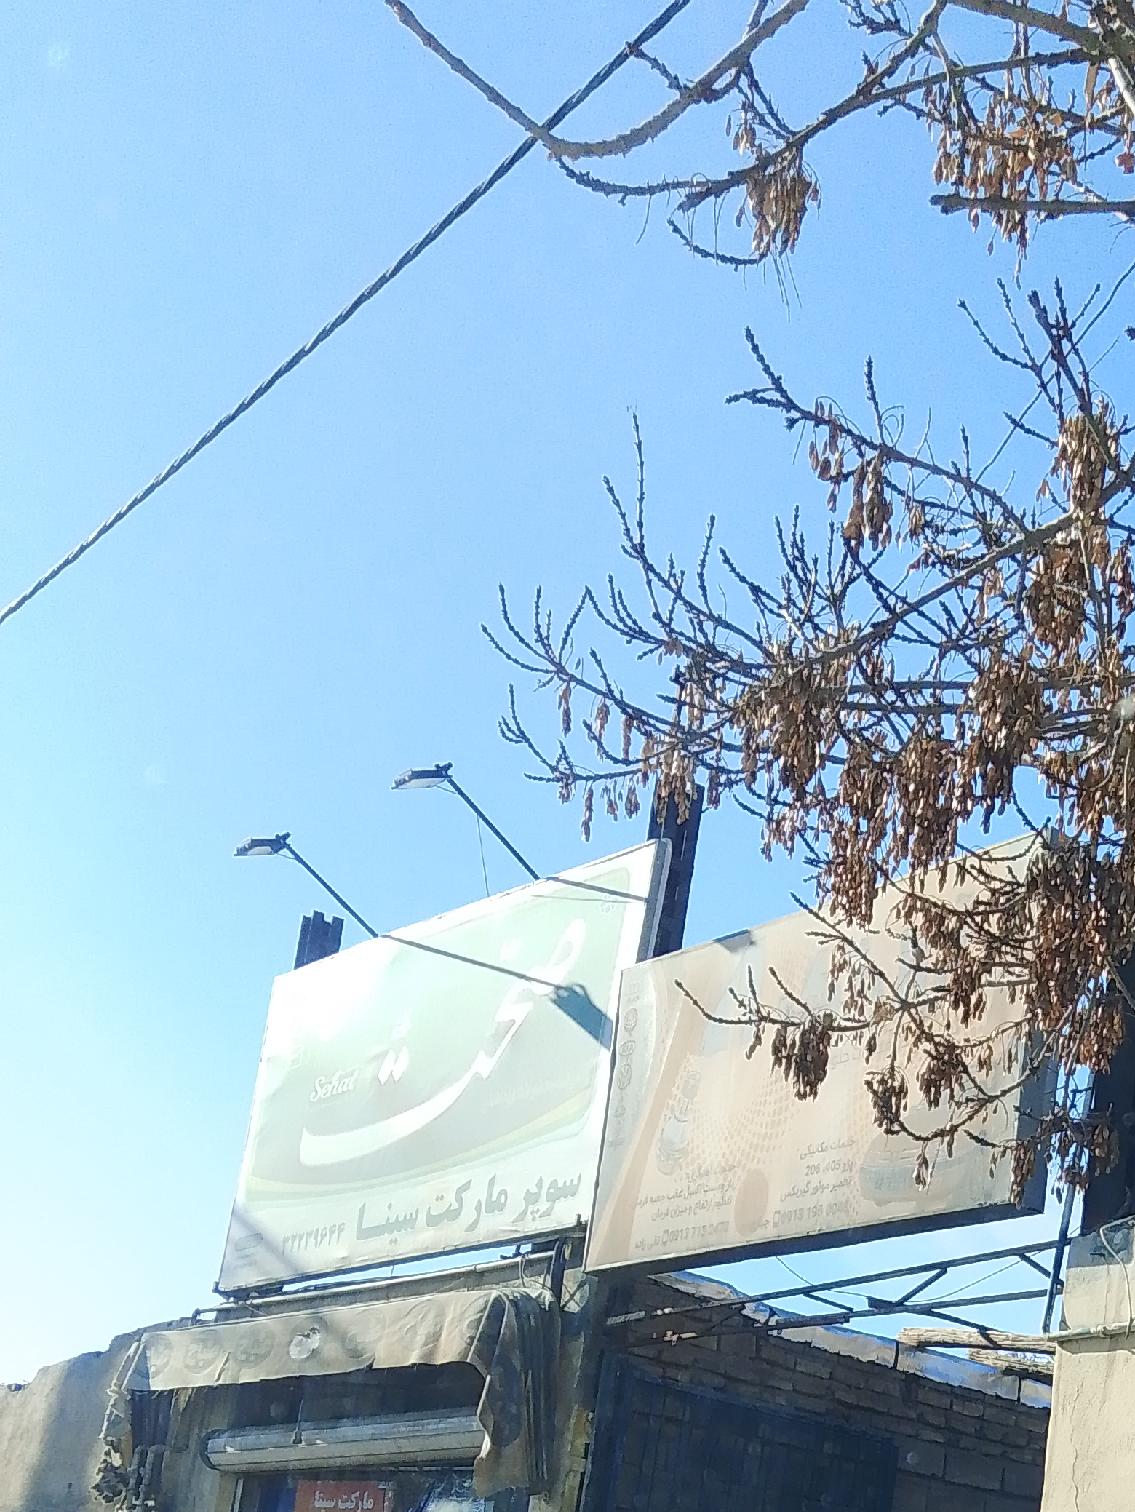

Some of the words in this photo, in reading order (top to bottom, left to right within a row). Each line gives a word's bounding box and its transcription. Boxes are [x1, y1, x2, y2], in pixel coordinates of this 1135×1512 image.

[426, 1175, 508, 1233] مارکت
[512, 1172, 582, 1224] سوپر
[356, 1201, 419, 1246] سینا
[313, 1490, 336, 1512] سینا
